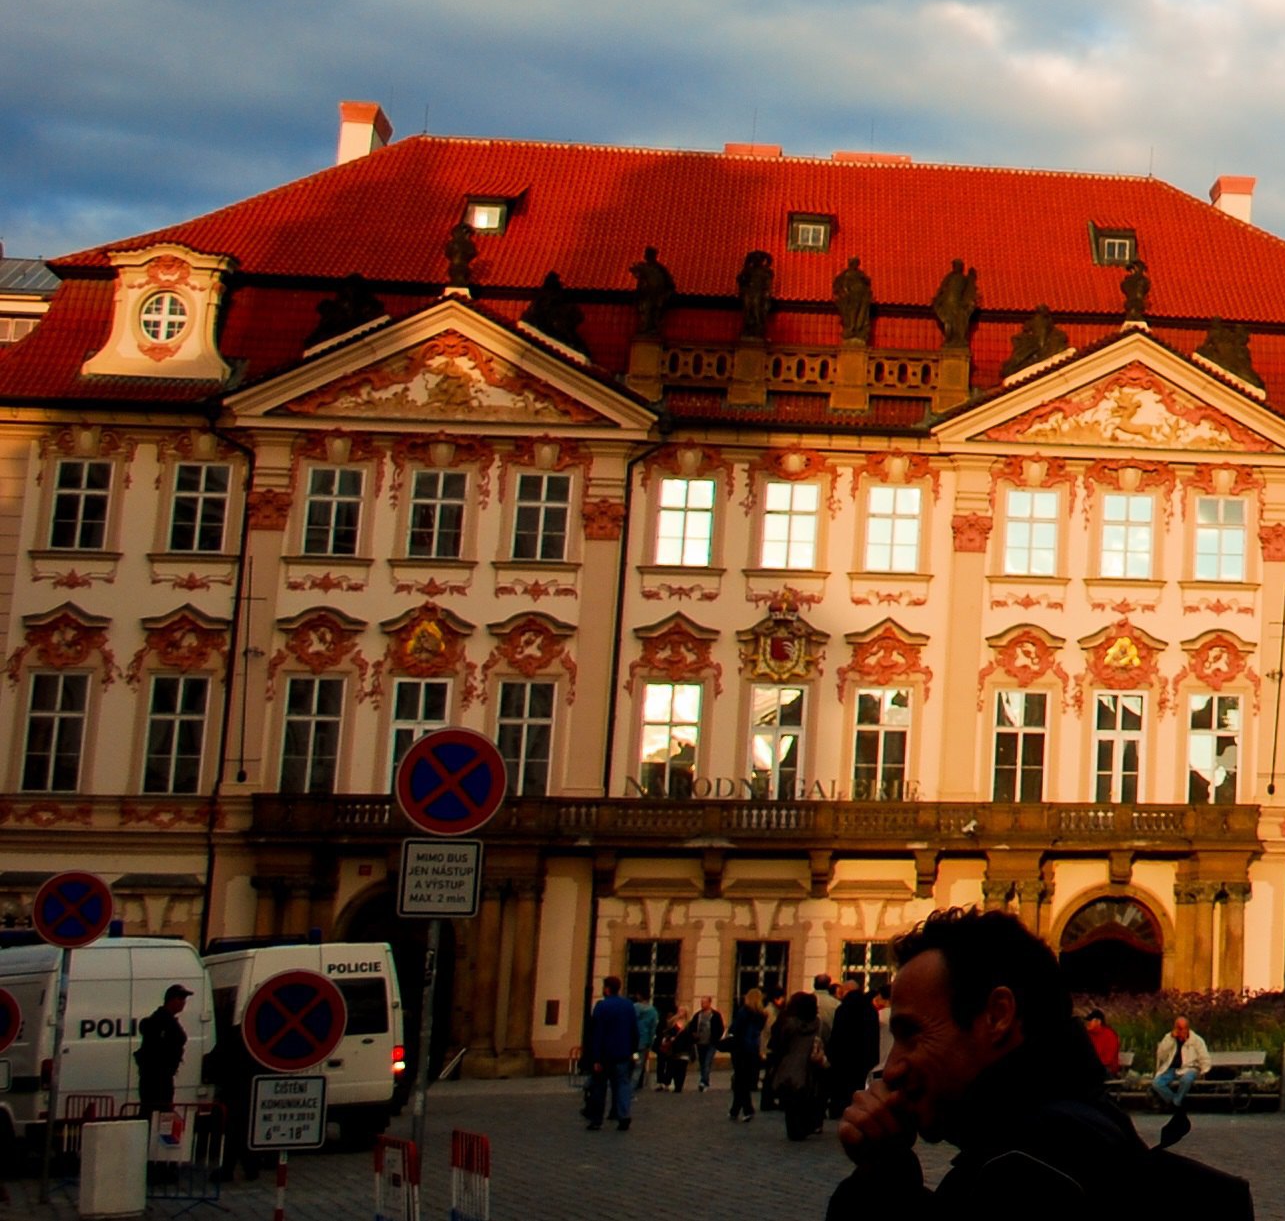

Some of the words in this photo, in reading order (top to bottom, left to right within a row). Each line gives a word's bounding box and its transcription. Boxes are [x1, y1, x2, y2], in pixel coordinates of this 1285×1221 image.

[416, 853, 444, 863] MIMO
[447, 853, 468, 863] BUS
[408, 866, 429, 876] JEN
[431, 864, 474, 877] NÁSTUP
[414, 880, 422, 889] A
[425, 878, 465, 890] VÝSTUP
[437, 893, 444, 903] 2
[328, 961, 382, 975] POLICIE
[261, 1098, 319, 1110] KOMUNIKACE
